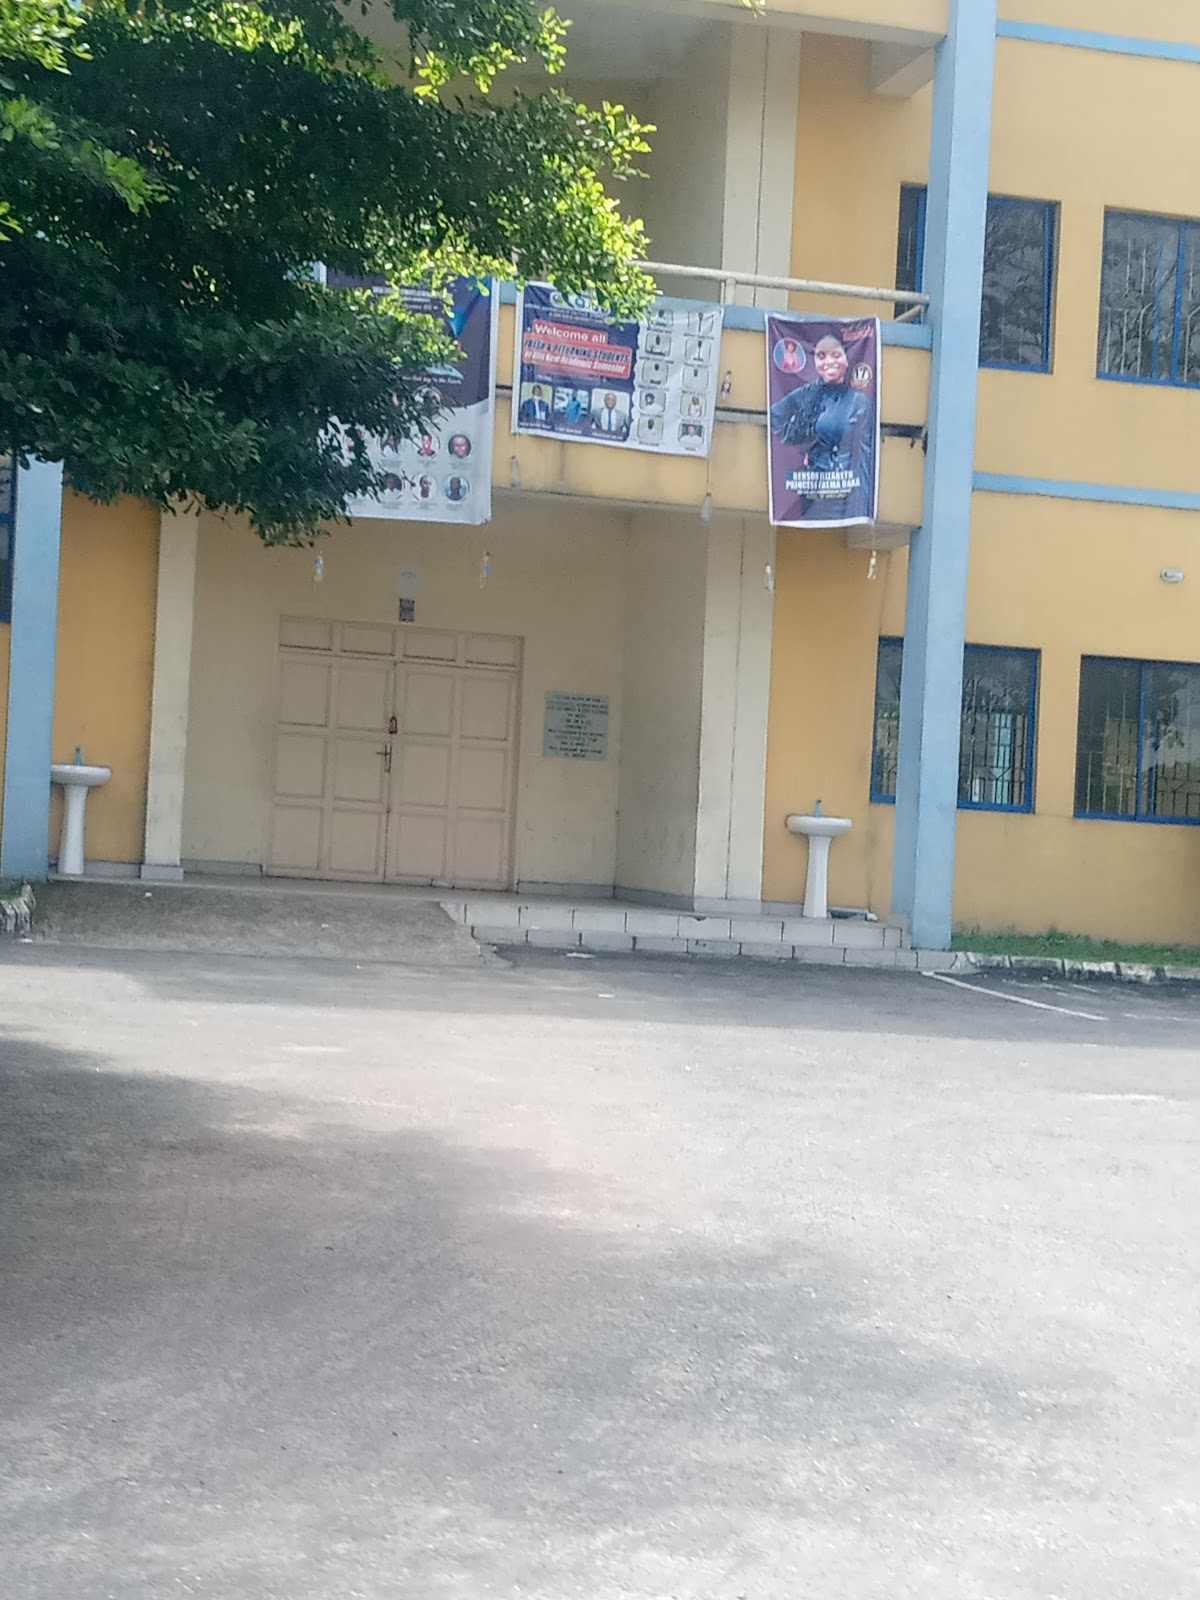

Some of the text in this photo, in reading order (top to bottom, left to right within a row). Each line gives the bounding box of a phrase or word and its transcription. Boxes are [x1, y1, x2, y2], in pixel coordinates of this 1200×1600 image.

[534, 323, 606, 343] Welcome all
[594, 350, 630, 363] STUDENTS
